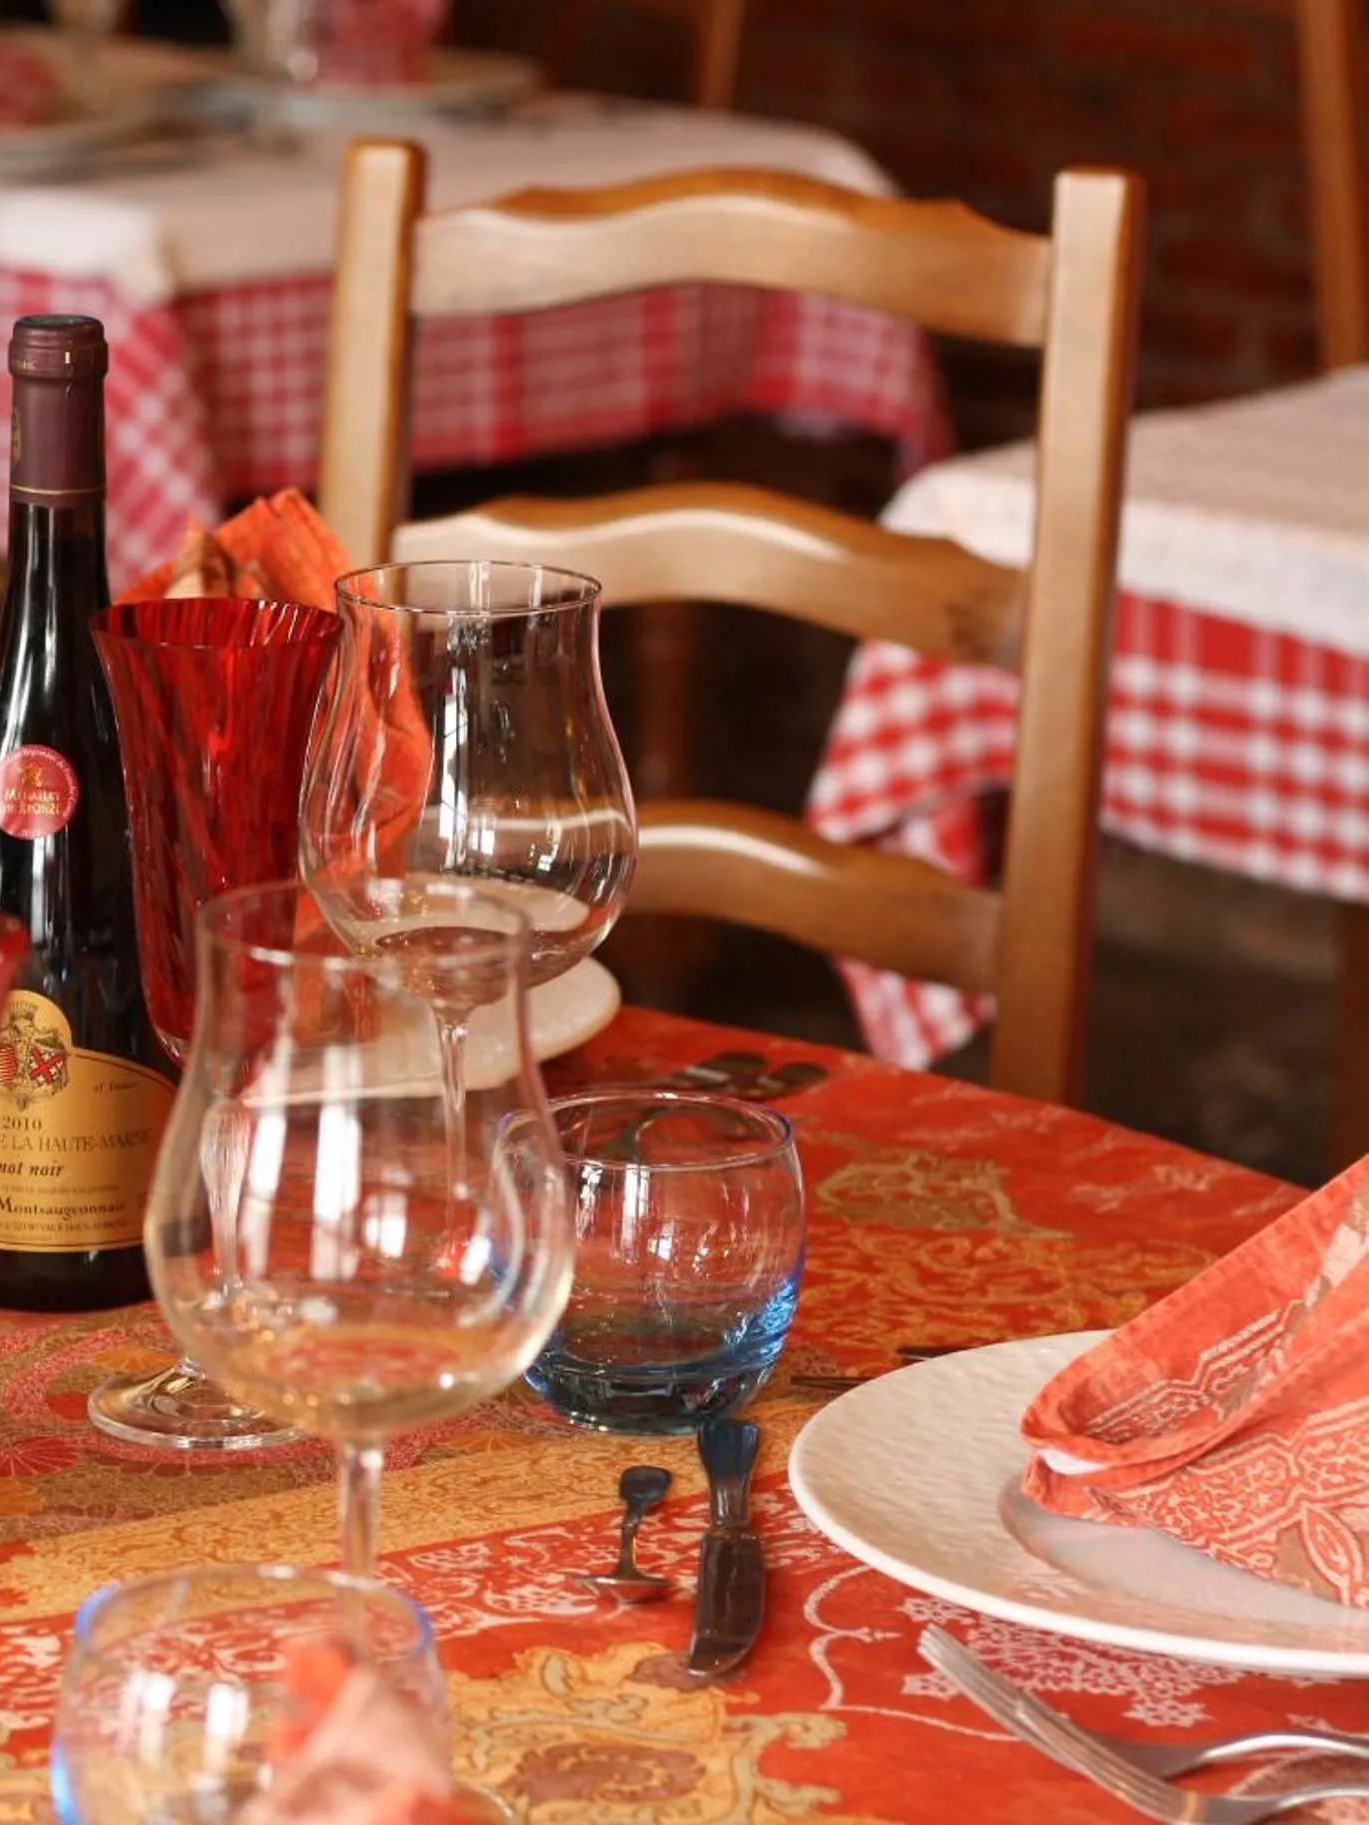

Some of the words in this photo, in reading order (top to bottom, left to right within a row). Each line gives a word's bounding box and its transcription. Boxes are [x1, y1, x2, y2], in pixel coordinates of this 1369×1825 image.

[2, 1116, 42, 1131] 2010
[11, 1135, 34, 1151] LA
[29, 1160, 64, 1177] noir
